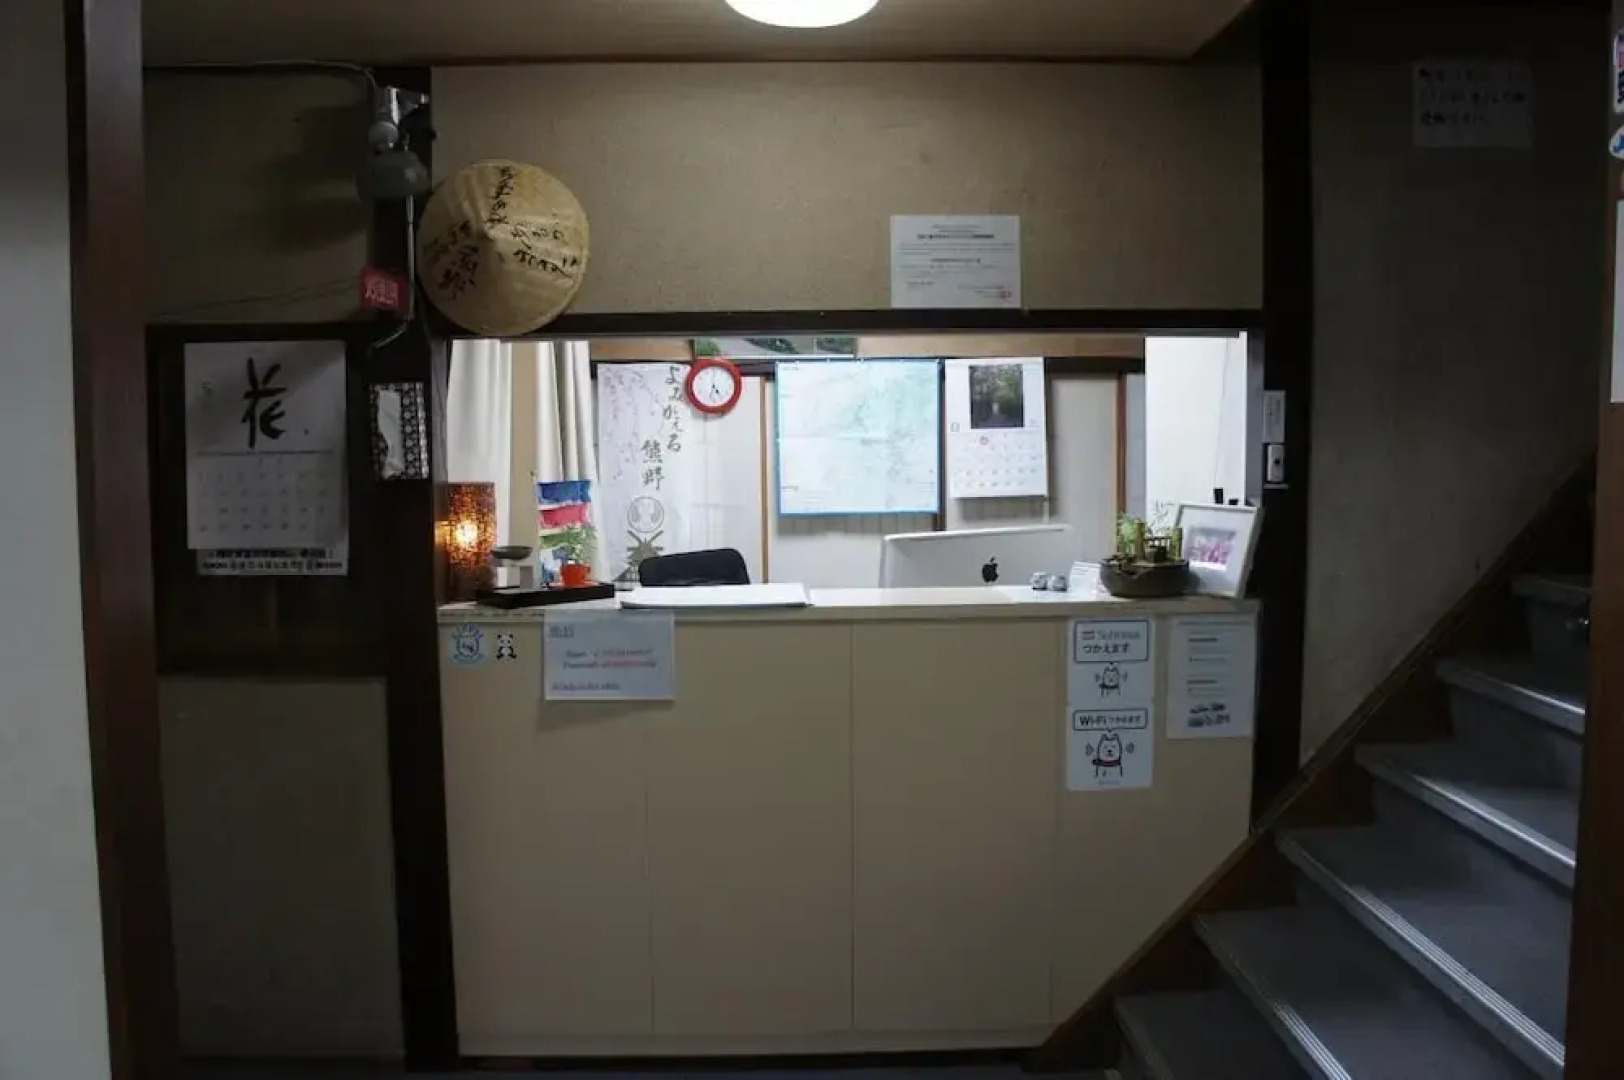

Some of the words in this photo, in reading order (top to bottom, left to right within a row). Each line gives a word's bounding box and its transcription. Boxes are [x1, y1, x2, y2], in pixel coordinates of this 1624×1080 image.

[241, 357, 287, 448] 花
[641, 439, 665, 491] 熊野
[1082, 643, 1130, 654] つかえます
